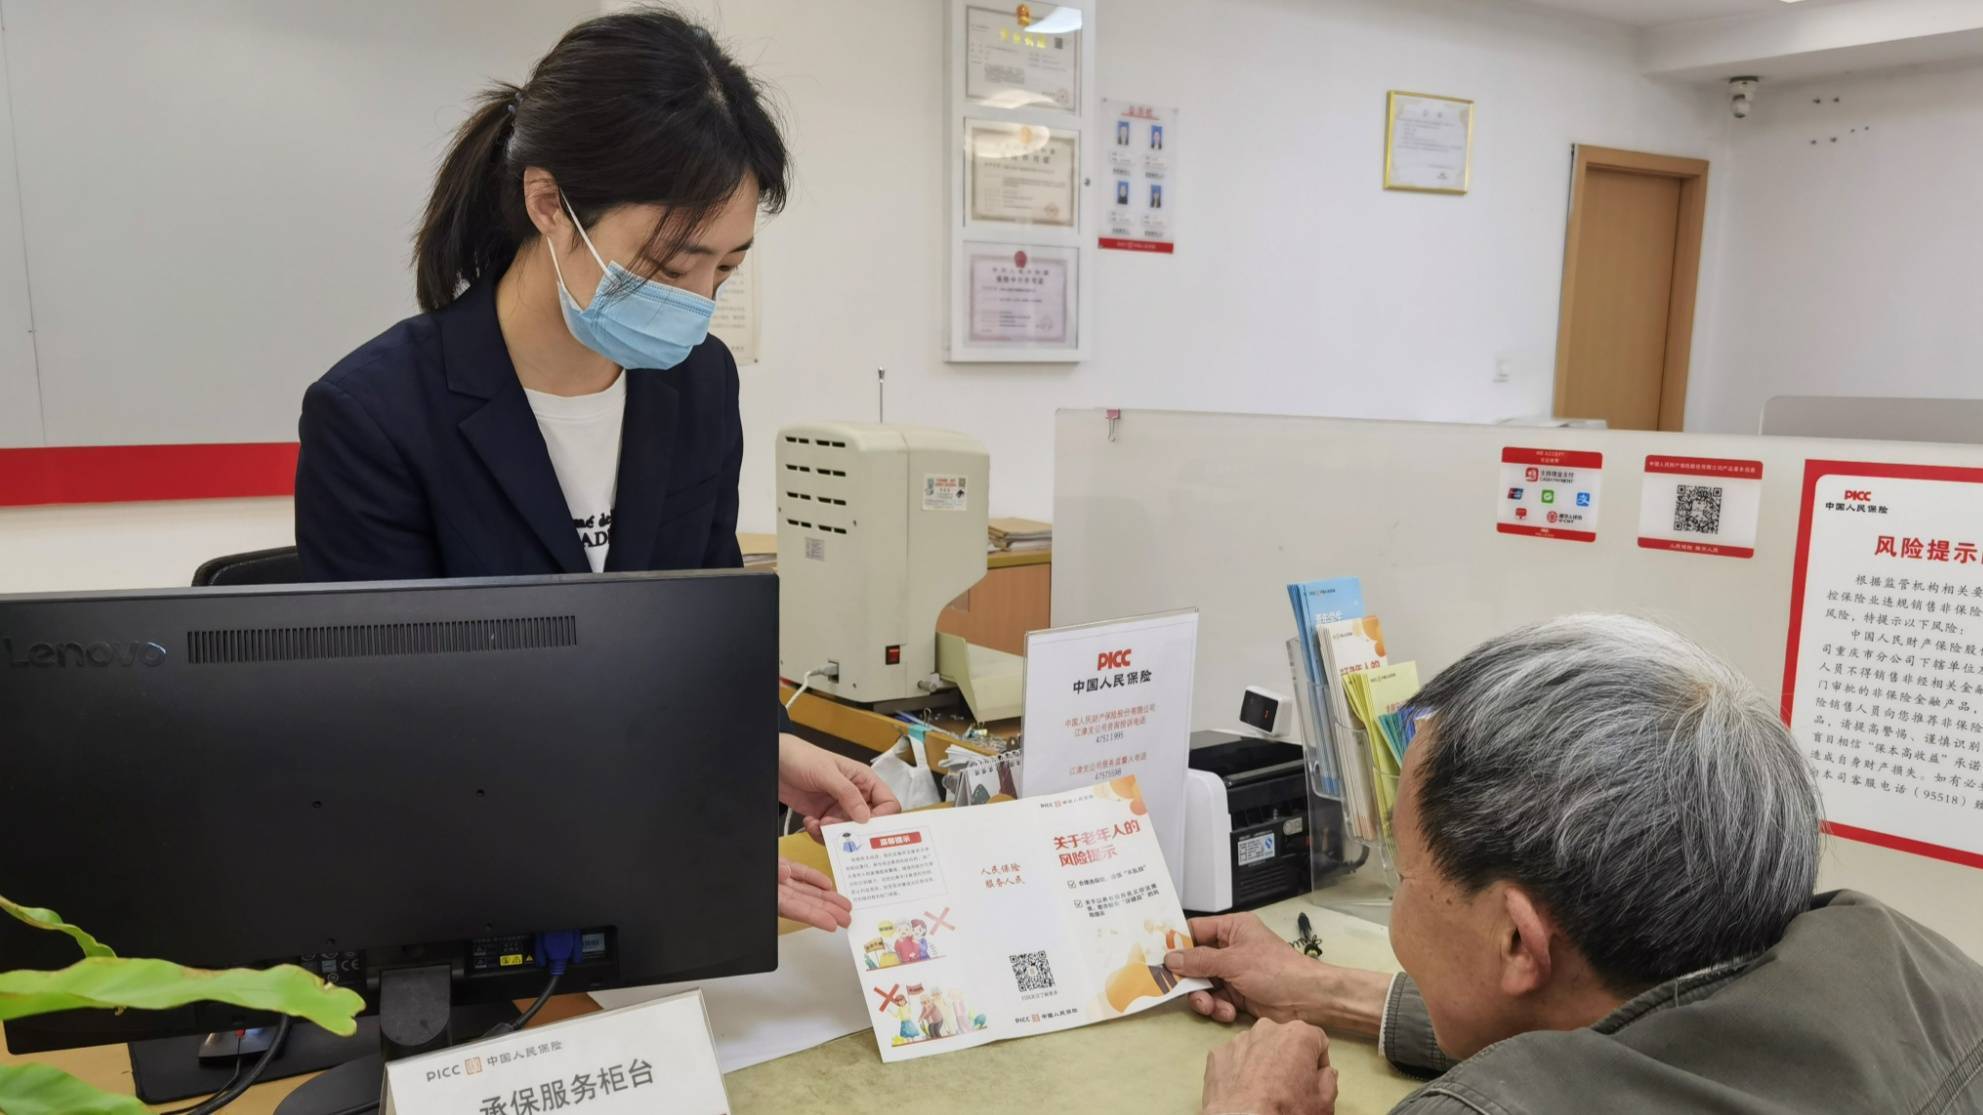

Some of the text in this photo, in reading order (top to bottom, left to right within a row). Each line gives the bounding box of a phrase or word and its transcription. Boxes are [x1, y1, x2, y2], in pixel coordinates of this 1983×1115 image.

[1825, 502, 1888, 514] 中国人民保险
[1844, 490, 1871, 502] PICC
[1875, 535, 1983, 565] 风险提示
[4, 638, 166, 668] Lenovo
[1097, 649, 1132, 671] PICC
[1073, 669, 1152, 694] 中国人民保险
[1053, 819, 1141, 850] 关于老年人的
[1058, 844, 1118, 867] 风险提示
[980, 863, 1021, 875] 人民保险
[985, 875, 1025, 888] 服务人民
[426, 1064, 461, 1082] PICC
[487, 1040, 563, 1067] 中国人民保险
[479, 1058, 654, 1115] 承保服务柜台
